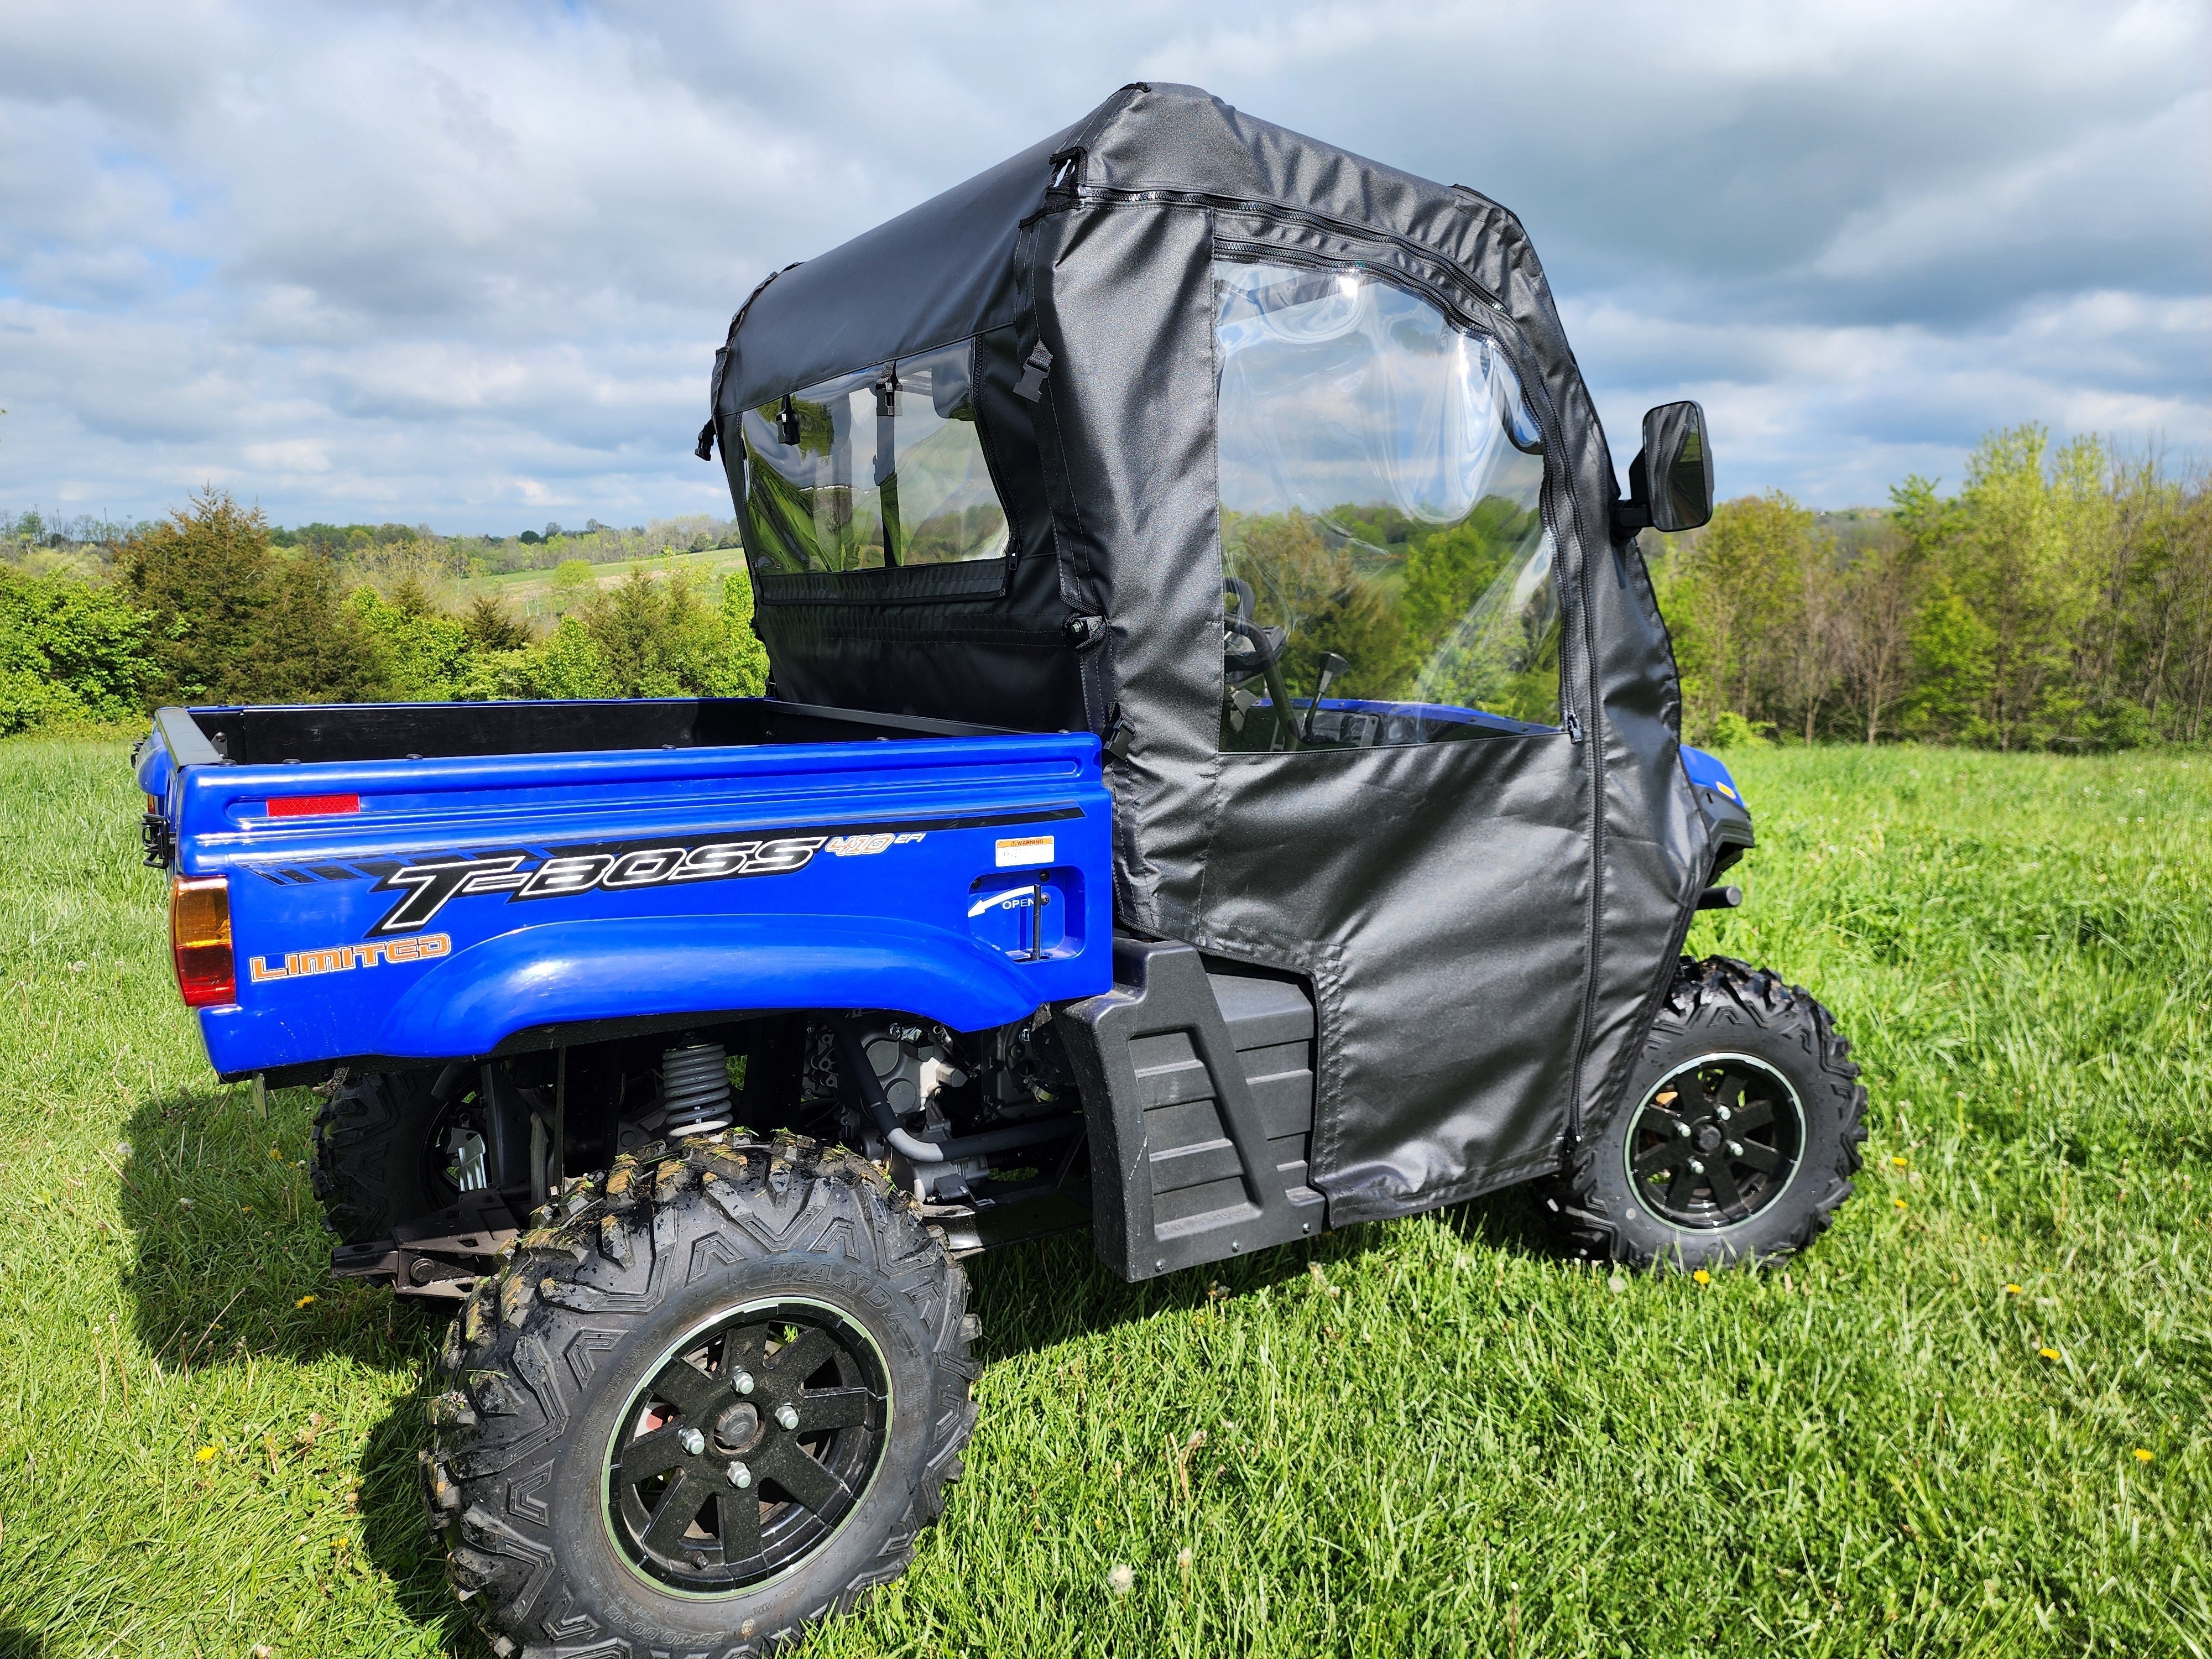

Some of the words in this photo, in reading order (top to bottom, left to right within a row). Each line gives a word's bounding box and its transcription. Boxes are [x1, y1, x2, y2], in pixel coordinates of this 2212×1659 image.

[381, 836, 829, 931] T-BOSS
[825, 833, 895, 857] 410
[893, 833, 926, 844] EFI
[249, 933, 452, 983] LIMITED
[770, 1260, 910, 1336] WANDA
